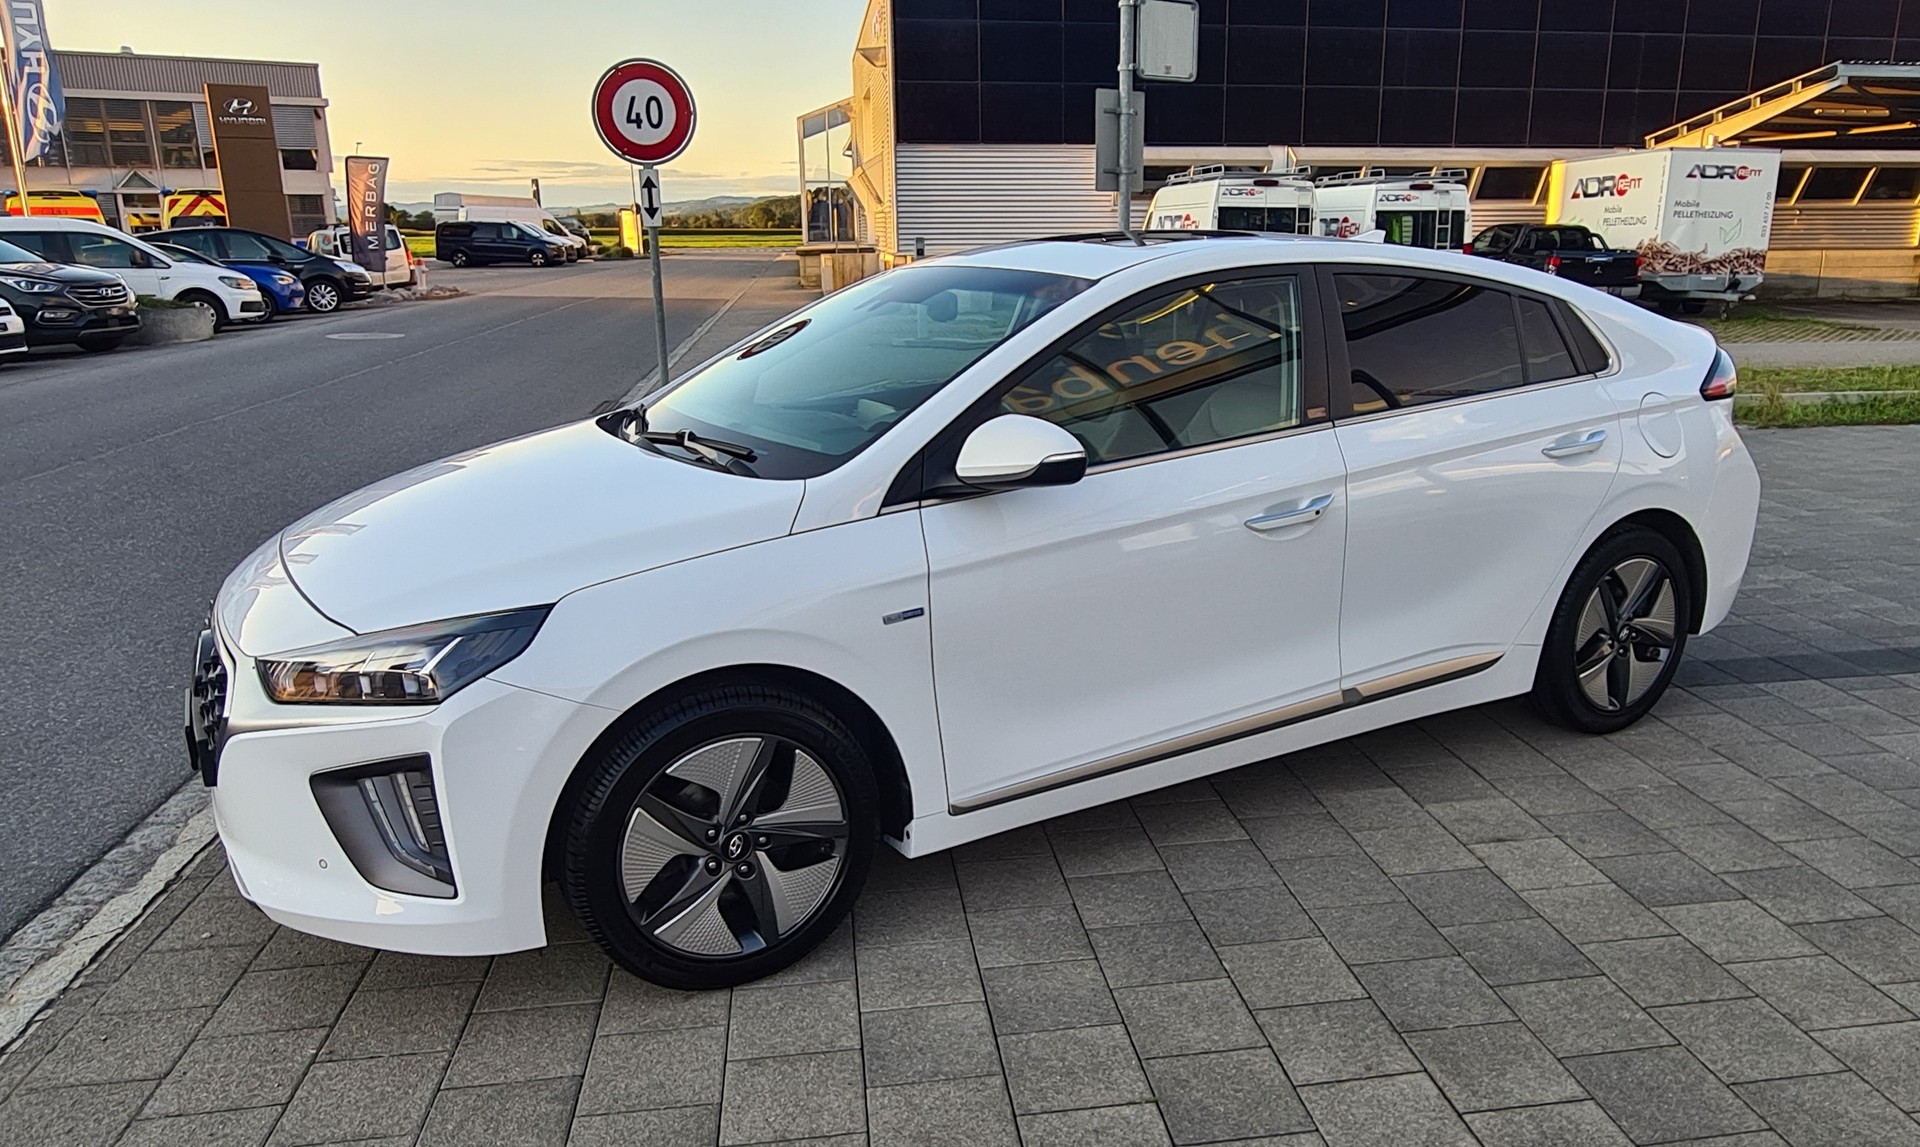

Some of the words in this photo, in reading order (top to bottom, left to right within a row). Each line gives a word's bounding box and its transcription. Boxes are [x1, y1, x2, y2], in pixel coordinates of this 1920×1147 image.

[626, 95, 663, 129] 40
[364, 163, 379, 250] MERBAG
[1604, 204, 1622, 213] Mobile
[1674, 200, 1700, 208] Mobile
[1673, 210, 1734, 219] PELLETHEIZUNG
